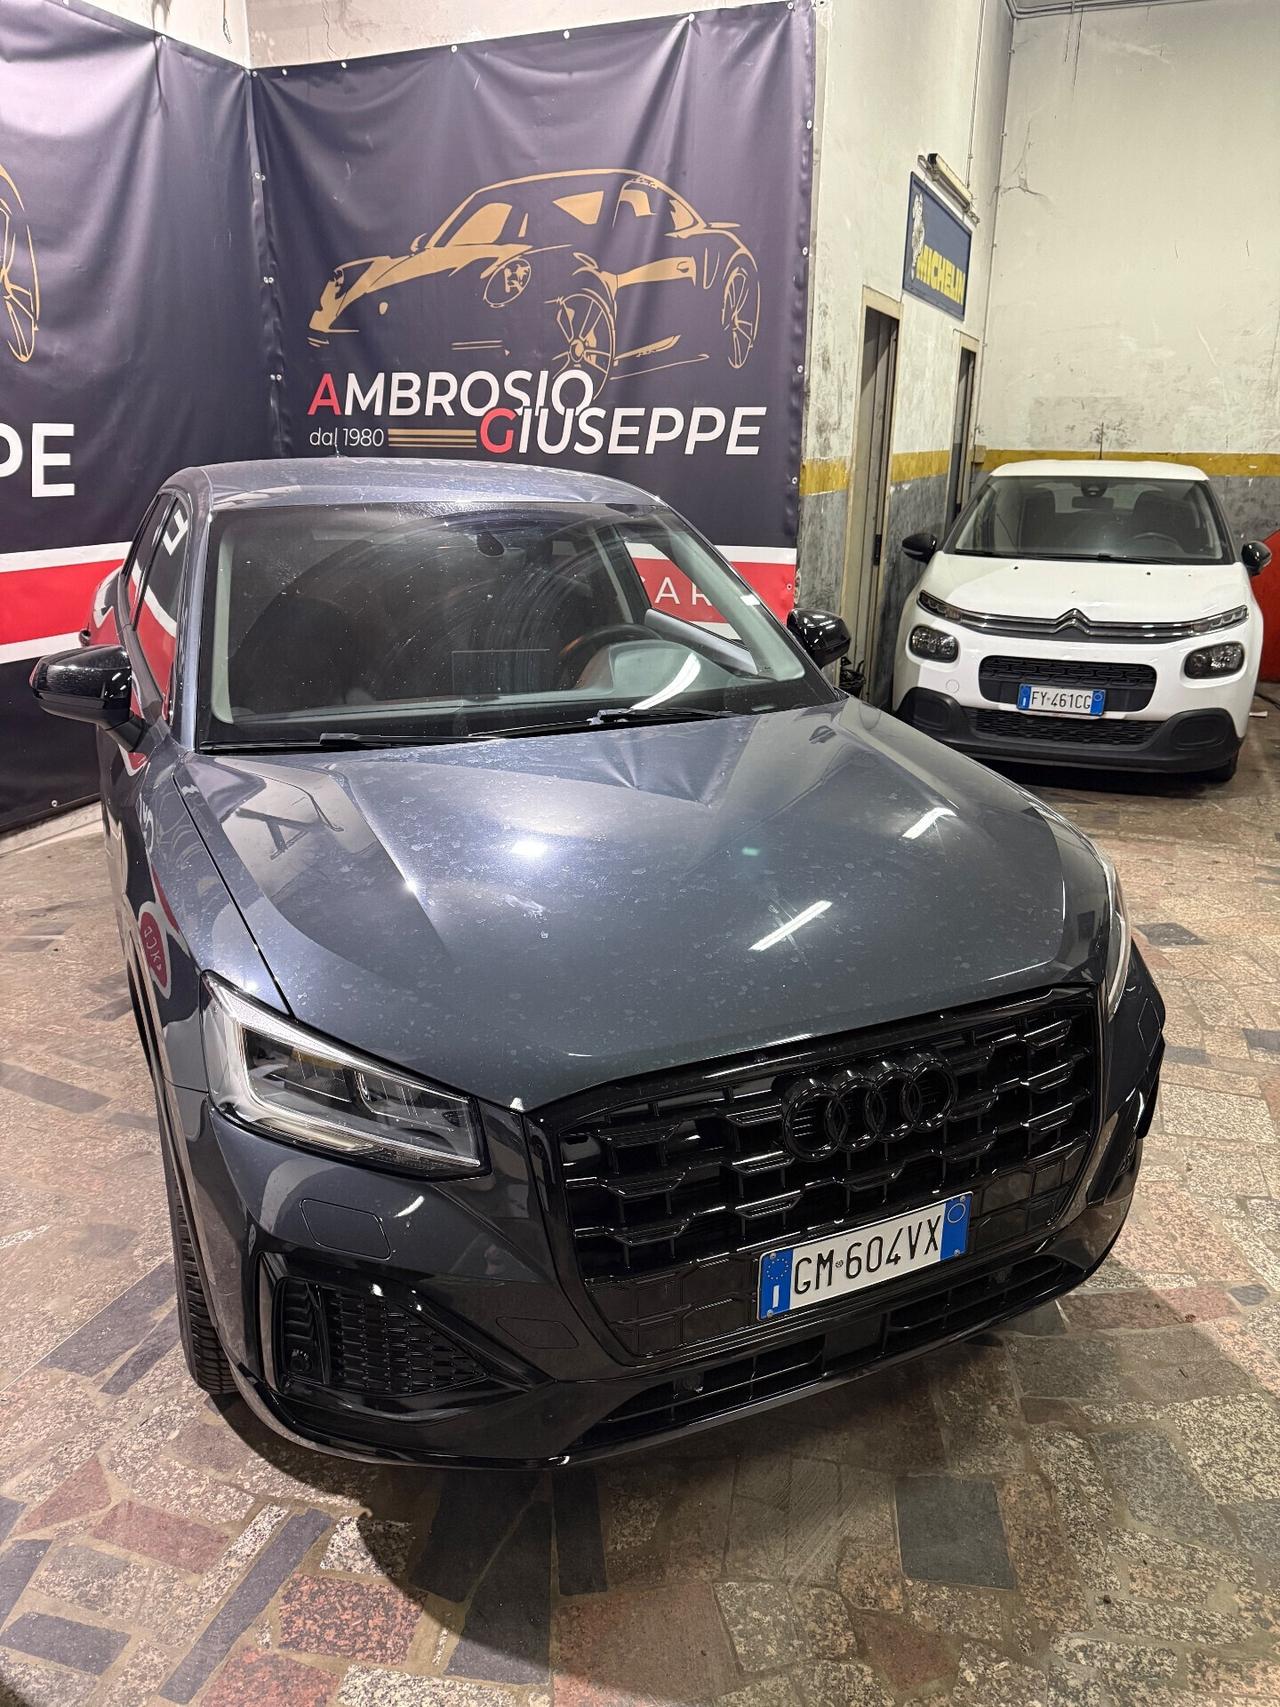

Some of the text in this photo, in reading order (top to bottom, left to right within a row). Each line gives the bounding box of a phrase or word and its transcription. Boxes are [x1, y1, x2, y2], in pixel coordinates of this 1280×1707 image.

[916, 244, 966, 305] MICHELIN
[307, 370, 594, 417] AMBROSIO
[309, 427, 384, 447] dal 1980
[480, 407, 767, 455] GIUSEPPE
